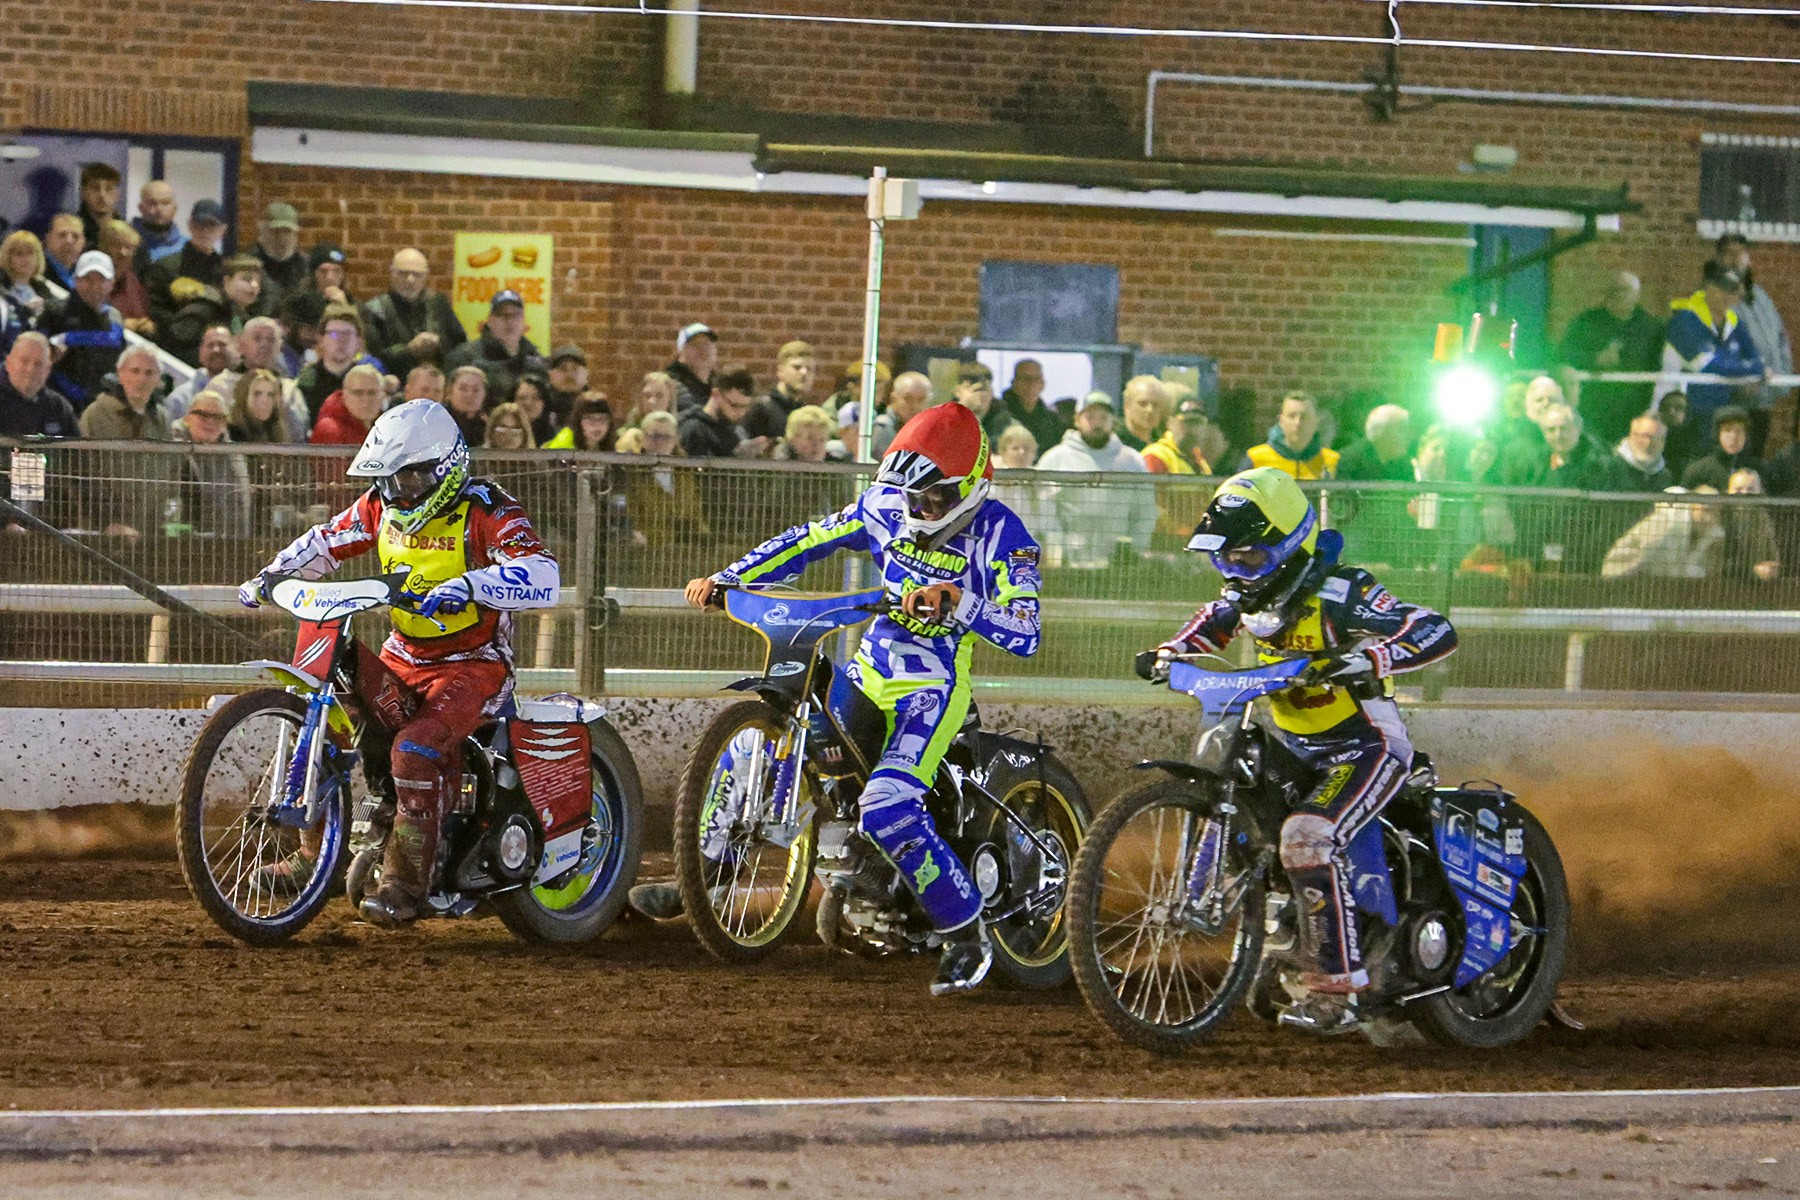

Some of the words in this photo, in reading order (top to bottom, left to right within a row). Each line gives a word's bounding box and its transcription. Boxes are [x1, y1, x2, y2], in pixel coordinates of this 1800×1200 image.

[457, 276, 498, 303] FOOD
[896, 554, 911, 564] CAR
[912, 558, 934, 574] SALES
[936, 568, 951, 578] LTD
[316, 587, 342, 597] Allied
